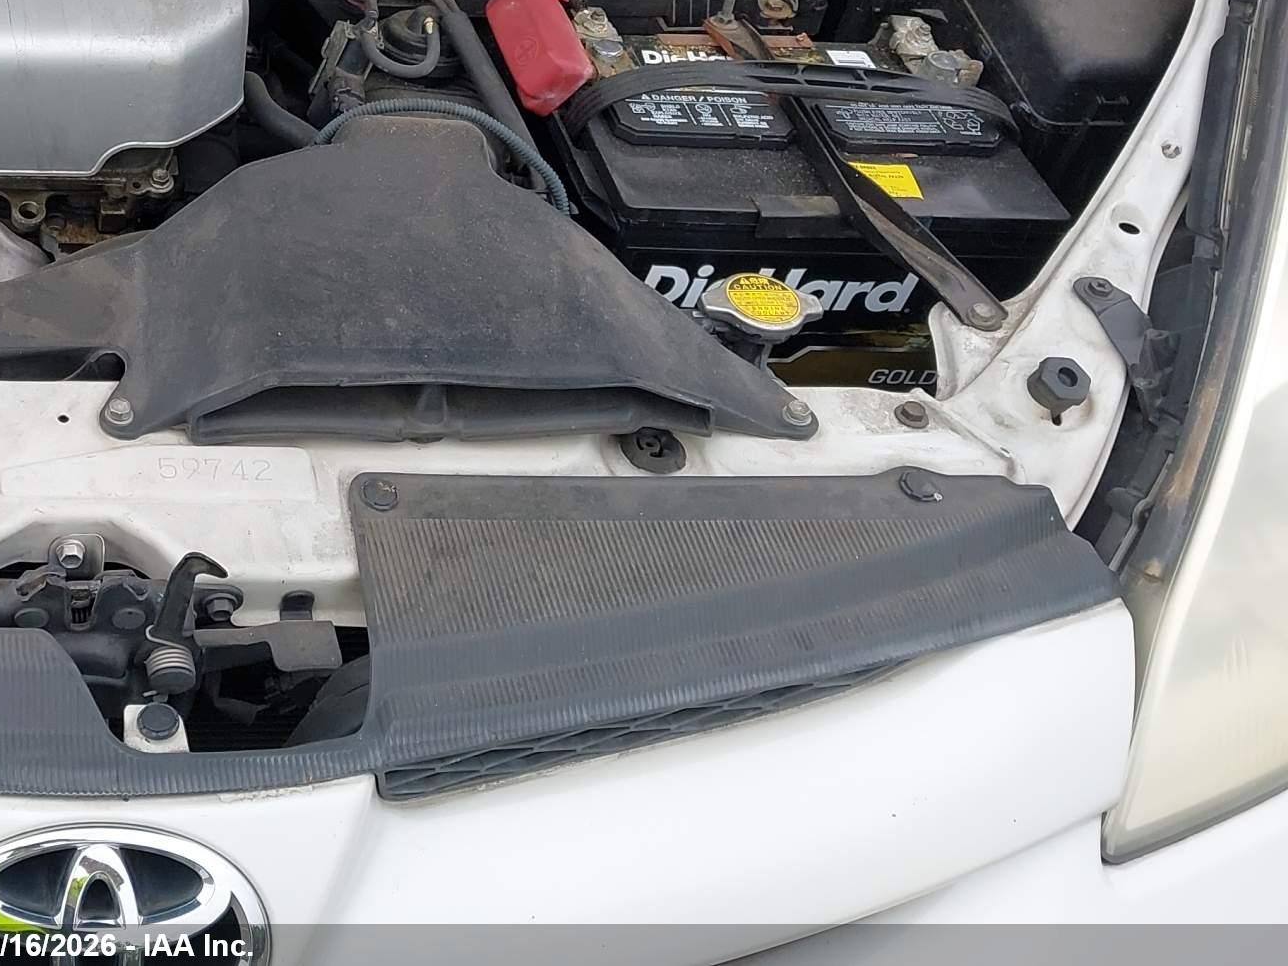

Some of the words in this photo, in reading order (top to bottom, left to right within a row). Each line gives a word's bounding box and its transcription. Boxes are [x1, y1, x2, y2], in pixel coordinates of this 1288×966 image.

[651, 94, 698, 102] DANGER
[706, 96, 747, 104] POISON
[733, 283, 783, 291] CAUTION
[868, 369, 937, 385] GOLD
